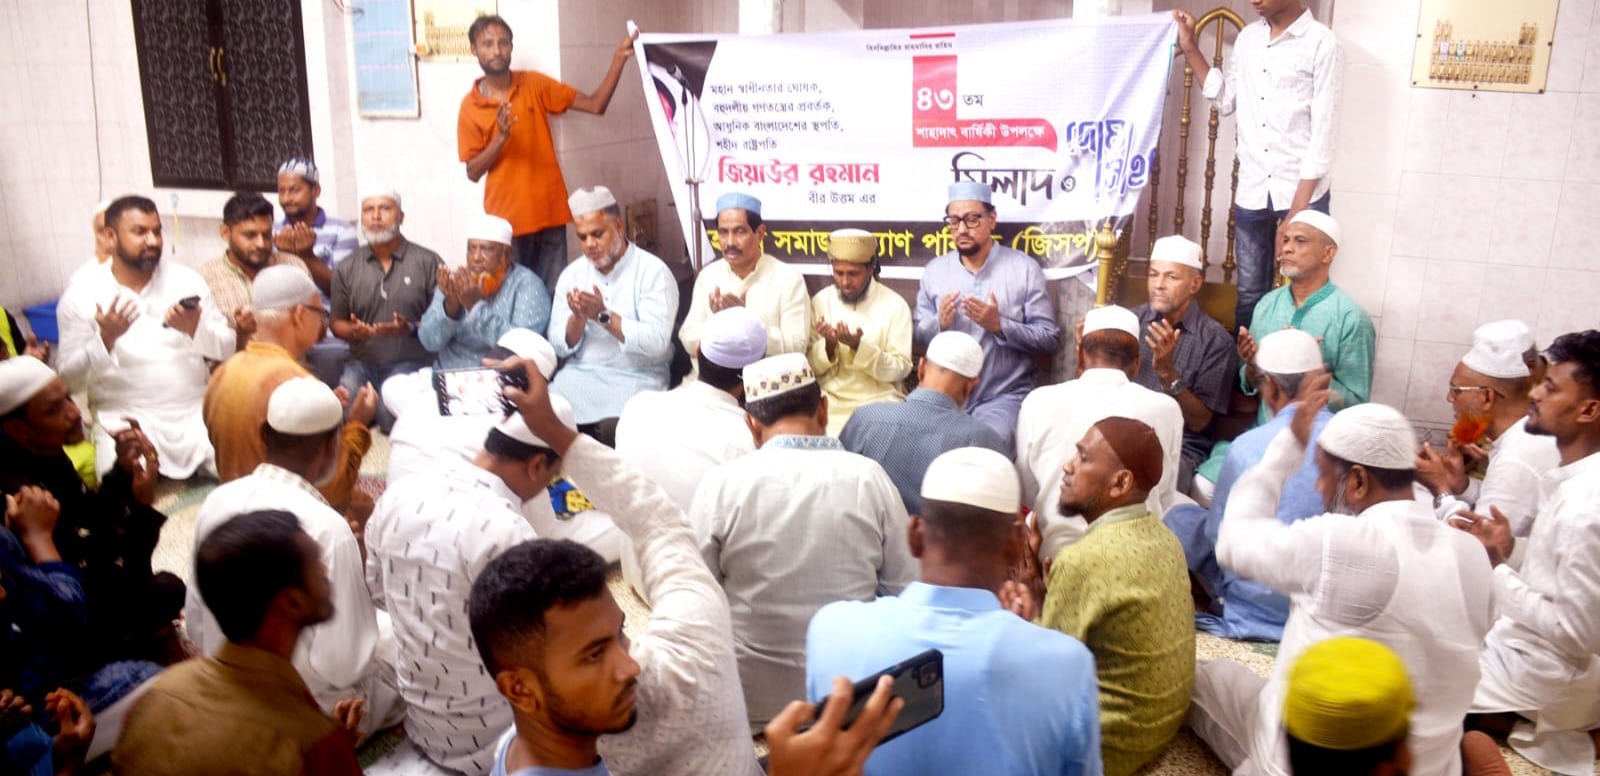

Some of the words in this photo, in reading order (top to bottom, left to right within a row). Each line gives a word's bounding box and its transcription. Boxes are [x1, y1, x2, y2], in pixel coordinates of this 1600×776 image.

[916, 86, 954, 111] ৪৩
[962, 94, 985, 107] তম
[713, 119, 750, 134] আধুনিক
[754, 119, 808, 132] বাংলাদেশের
[960, 122, 997, 140] বার্ষিকী
[1000, 122, 1046, 139] উপলক্ষে
[715, 138, 738, 151] শহীদ
[718, 155, 799, 186] জিয়াউর
[808, 162, 880, 186] রহমান
[808, 189, 826, 205] বীর
[829, 190, 855, 205] উত্তম
[859, 193, 876, 205] এর
